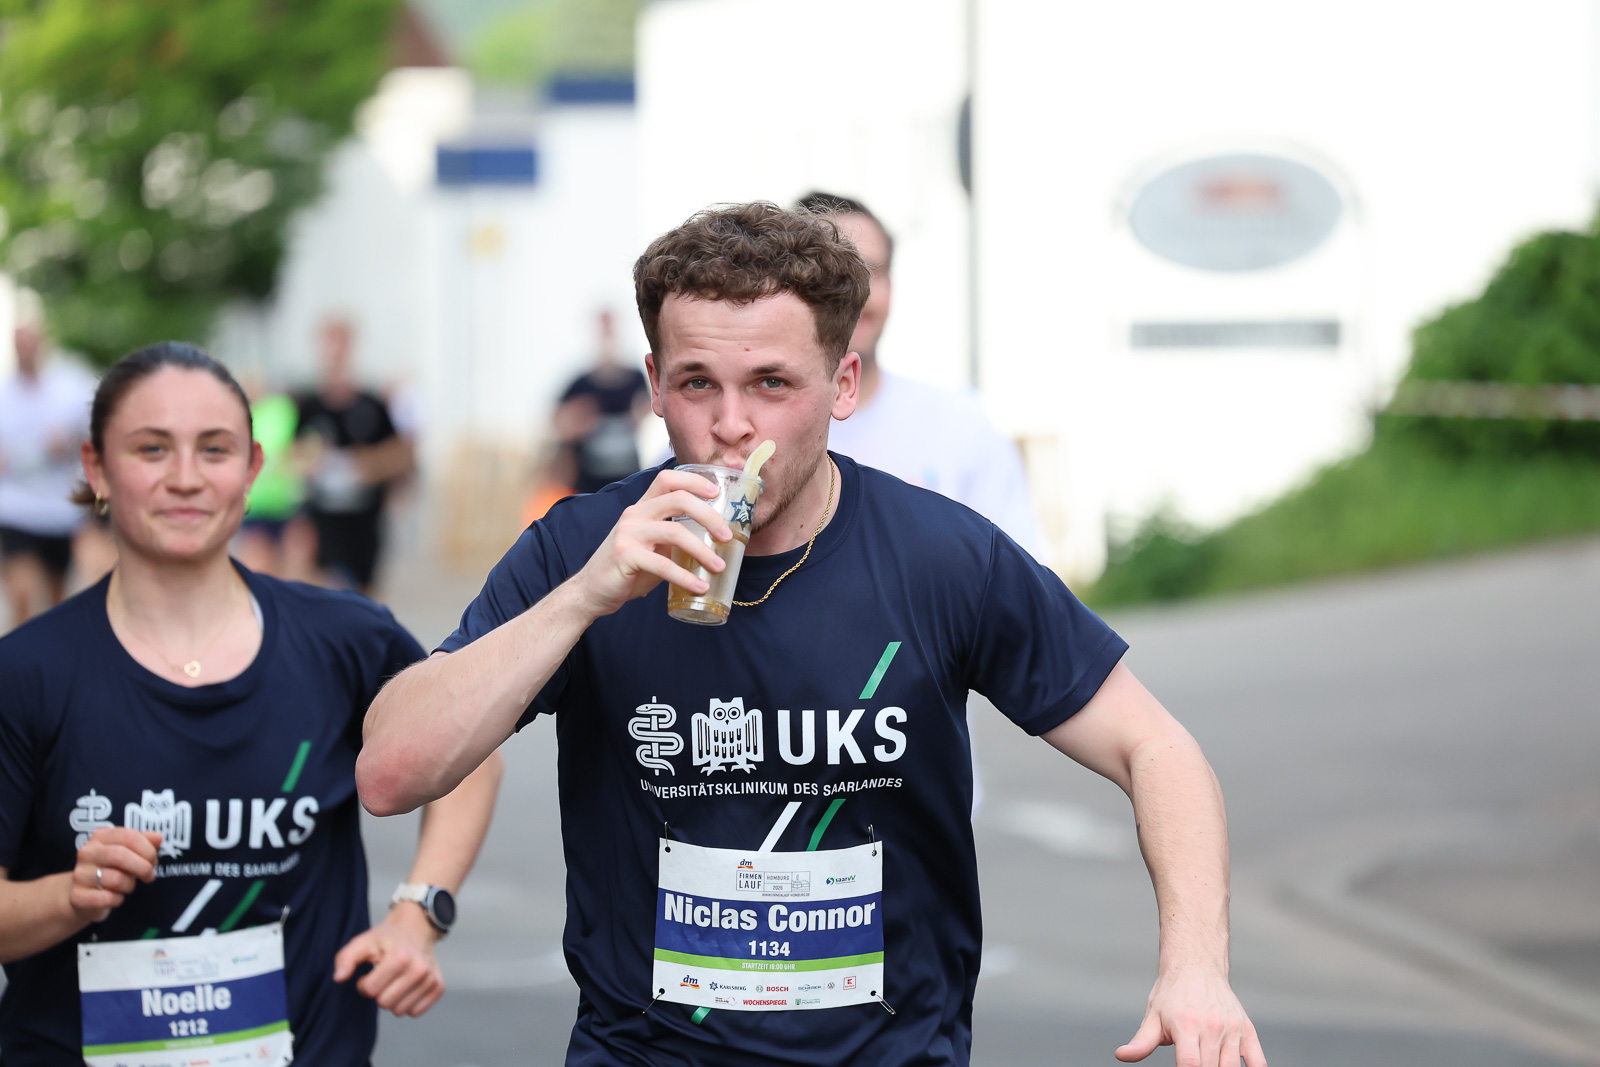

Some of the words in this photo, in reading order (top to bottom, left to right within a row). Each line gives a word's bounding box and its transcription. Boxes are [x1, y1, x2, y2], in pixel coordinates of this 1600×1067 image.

[777, 706, 908, 765] UKS
[793, 782, 818, 796] DES
[823, 777, 903, 796] SAARLANDES
[205, 796, 319, 849] UKS
[739, 872, 762, 880] FIRMEN
[739, 880, 762, 889] LAUF
[664, 892, 758, 930] Niclas
[768, 901, 876, 932] Connor
[748, 940, 791, 957] 1134
[741, 962, 768, 970] STARTZEIT
[141, 984, 232, 1017] Noelle
[168, 1018, 209, 1037] 1212
